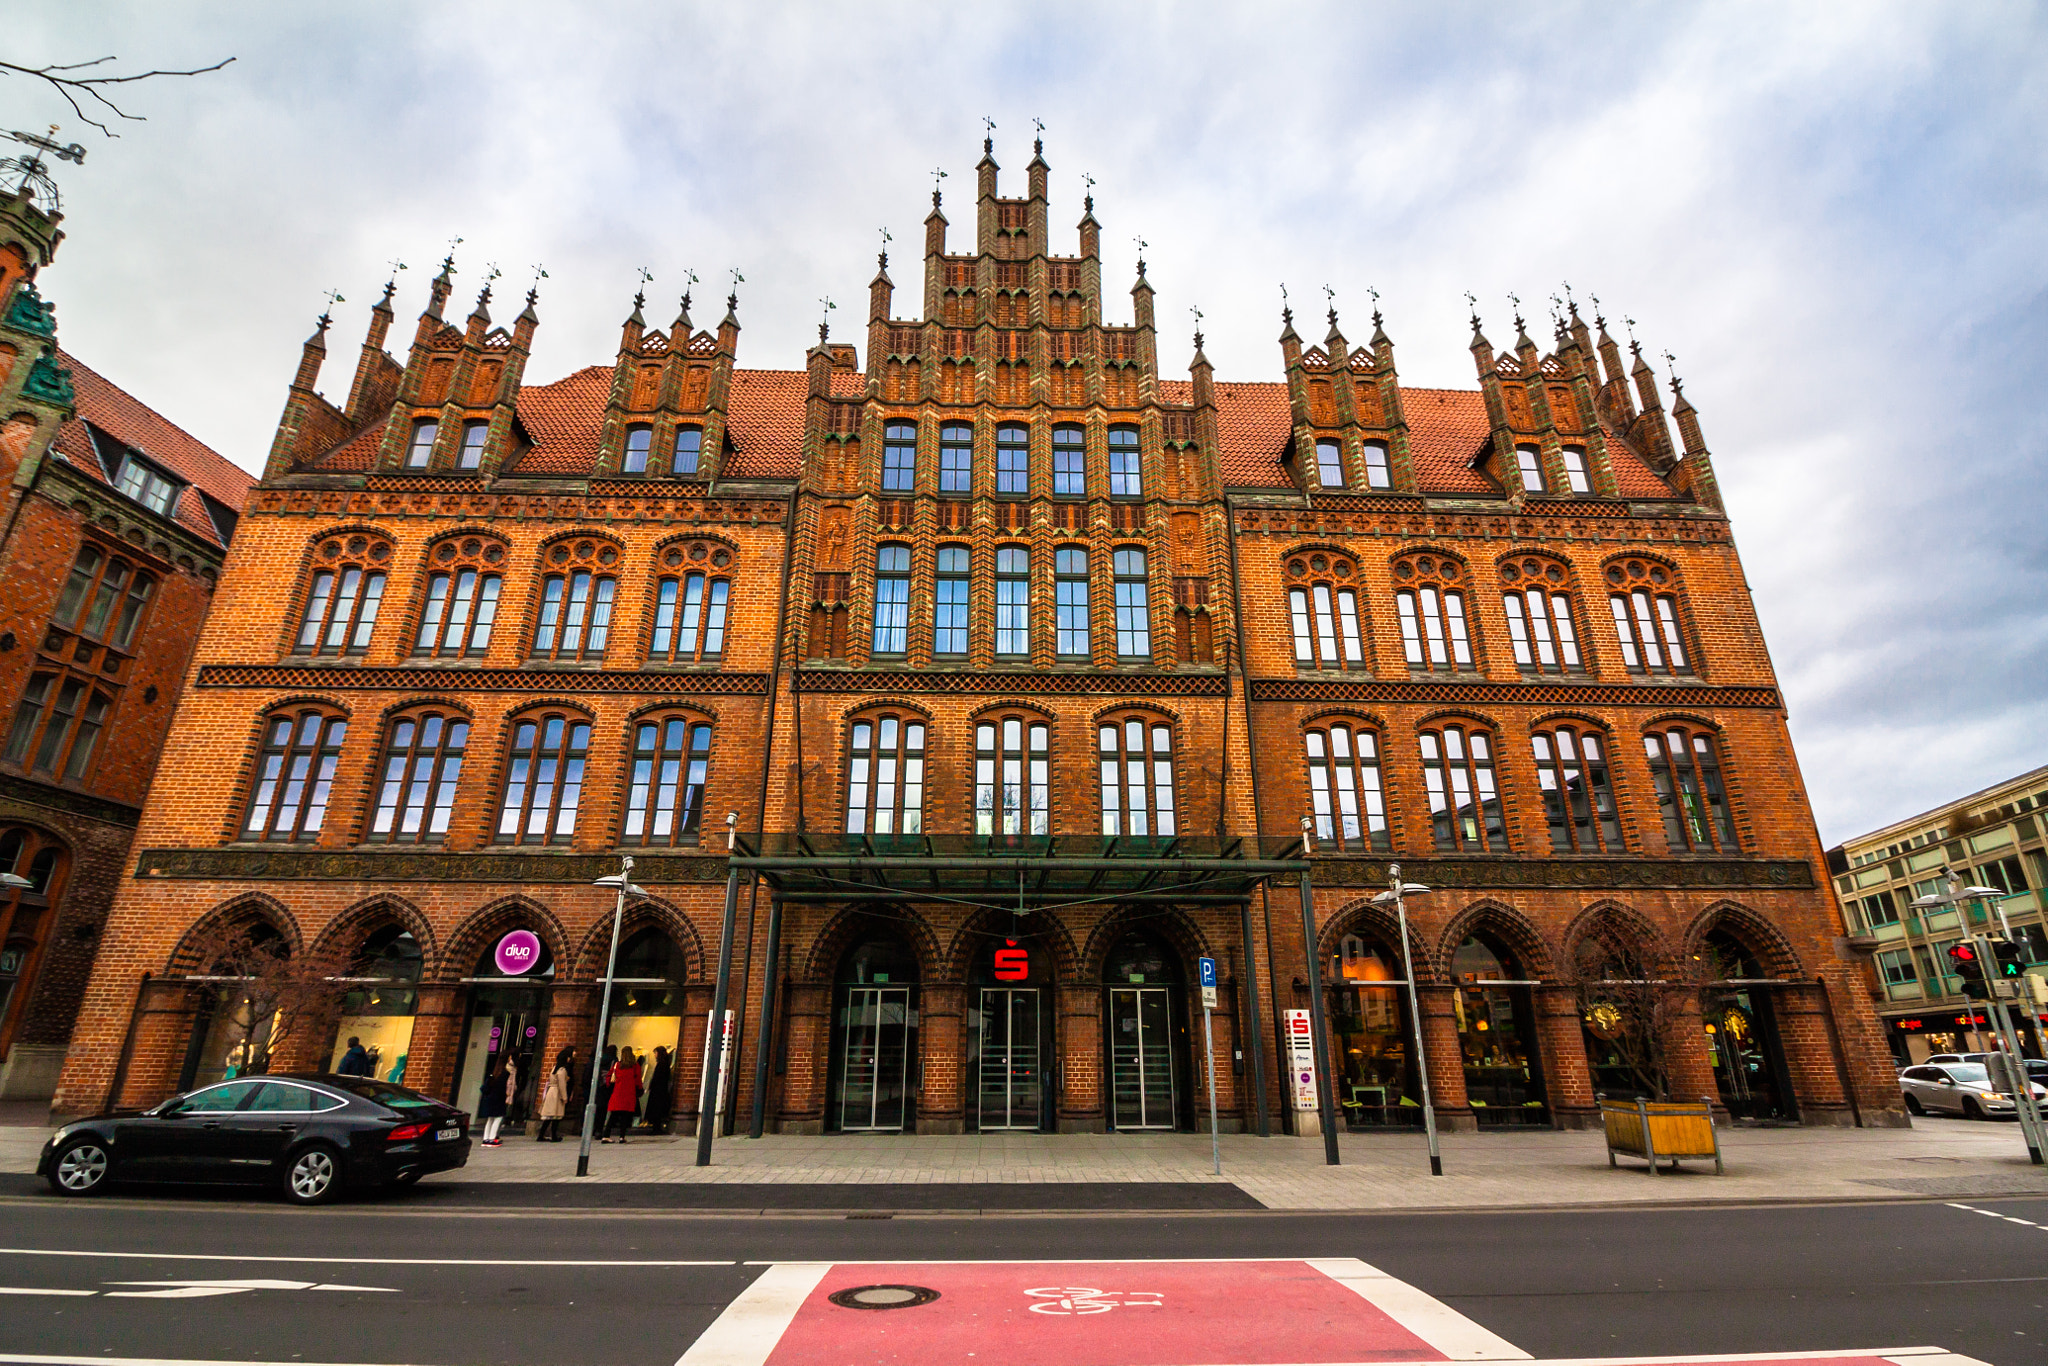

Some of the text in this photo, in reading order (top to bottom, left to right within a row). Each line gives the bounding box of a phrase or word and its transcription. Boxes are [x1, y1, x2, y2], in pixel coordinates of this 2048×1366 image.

[505, 943, 531, 957] divo
[994, 949, 1029, 980] S
[1203, 961, 1212, 983] P
[1292, 1019, 1309, 1034] S
